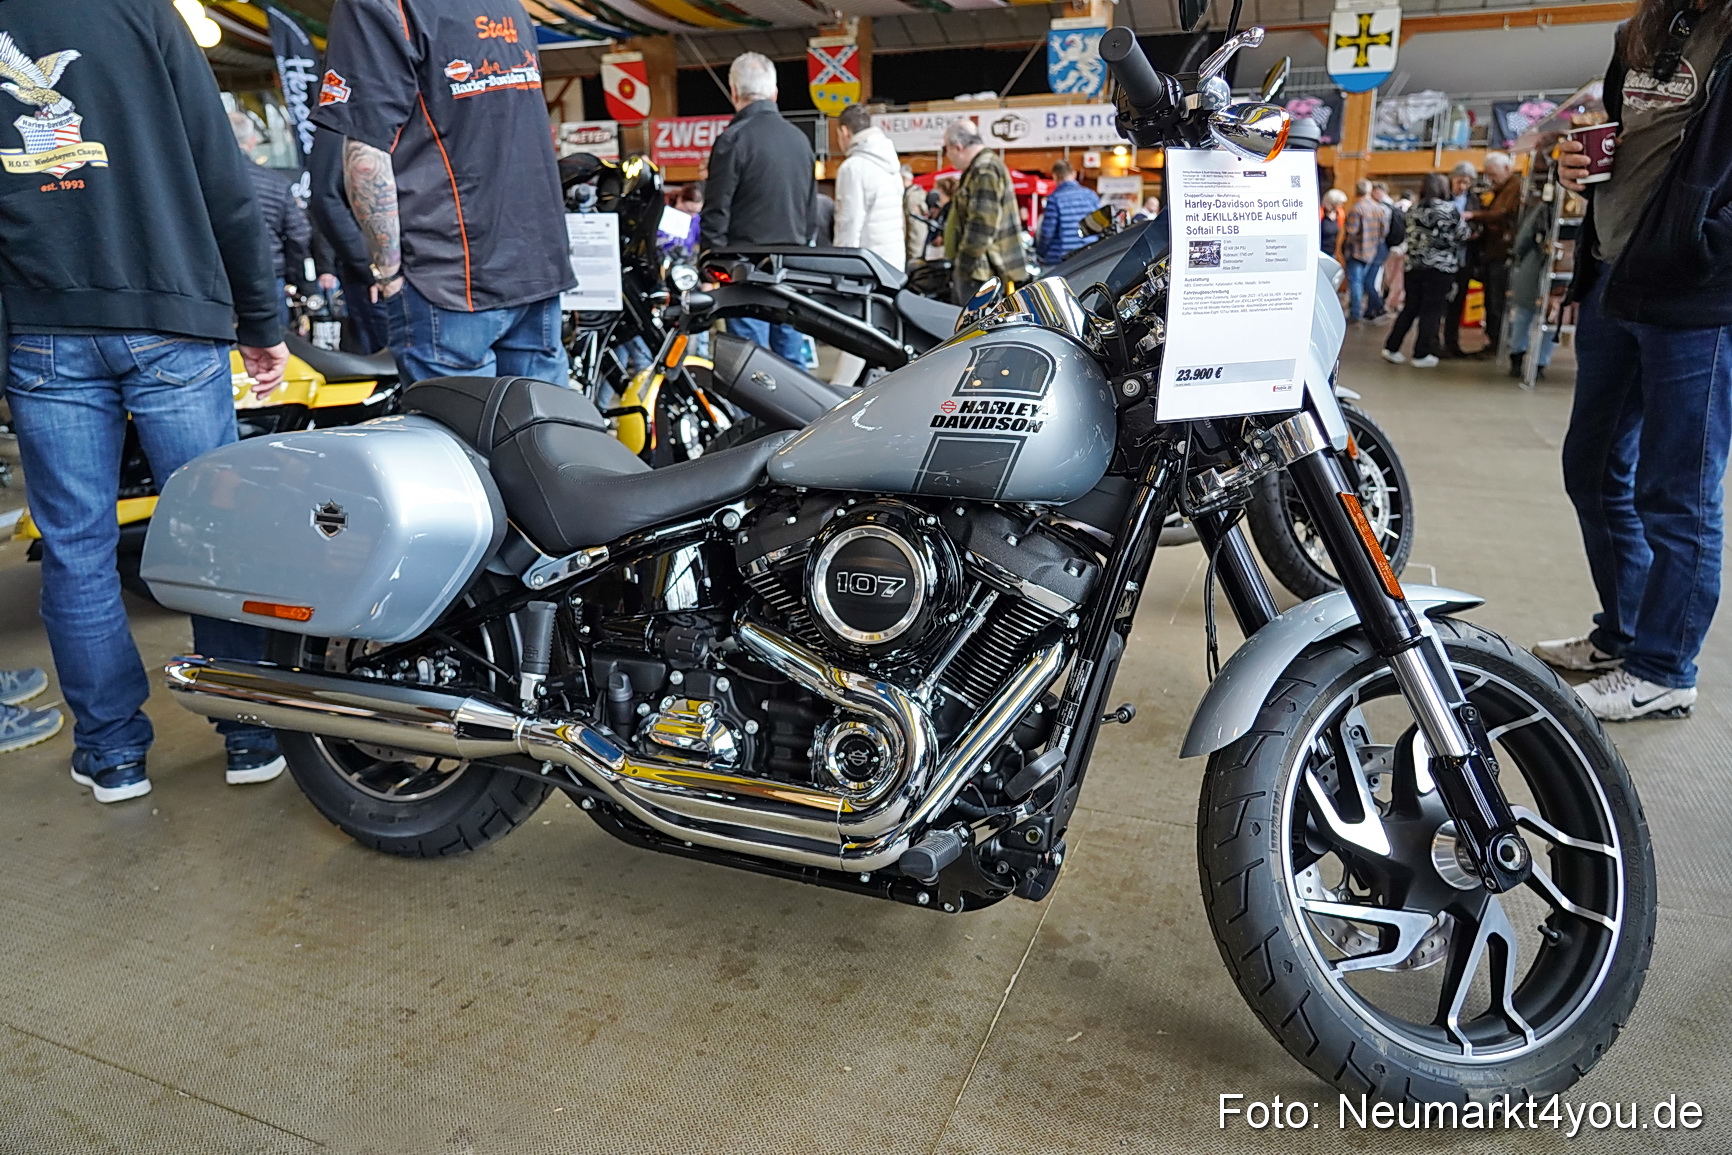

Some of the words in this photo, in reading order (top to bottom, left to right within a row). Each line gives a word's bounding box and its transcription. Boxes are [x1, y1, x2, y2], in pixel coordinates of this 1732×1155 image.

[475, 16, 518, 43] Staff
[450, 73, 526, 95] Harley-Davidson
[22, 116, 74, 130] Harley-Davidson
[881, 116, 965, 132] NEUMAR
[40, 183, 58, 192] est.
[59, 180, 85, 189] 1993
[1184, 199, 1255, 210] Harley-Davidson
[1257, 199, 1280, 209] Sport
[1282, 198, 1303, 208] Glide
[1186, 213, 1199, 221] mit
[1202, 212, 1263, 221] JEKILL&HYDE
[1265, 212, 1297, 222] Auspuff
[1186, 226, 1214, 235] Softail
[1216, 225, 1239, 234] FLSB
[1176, 368, 1213, 381] 23.900
[1215, 367, 1223, 379] €
[958, 400, 1048, 417] HARLEY-
[930, 415, 1044, 433] DAVIDSON
[836, 572, 906, 598] 107
